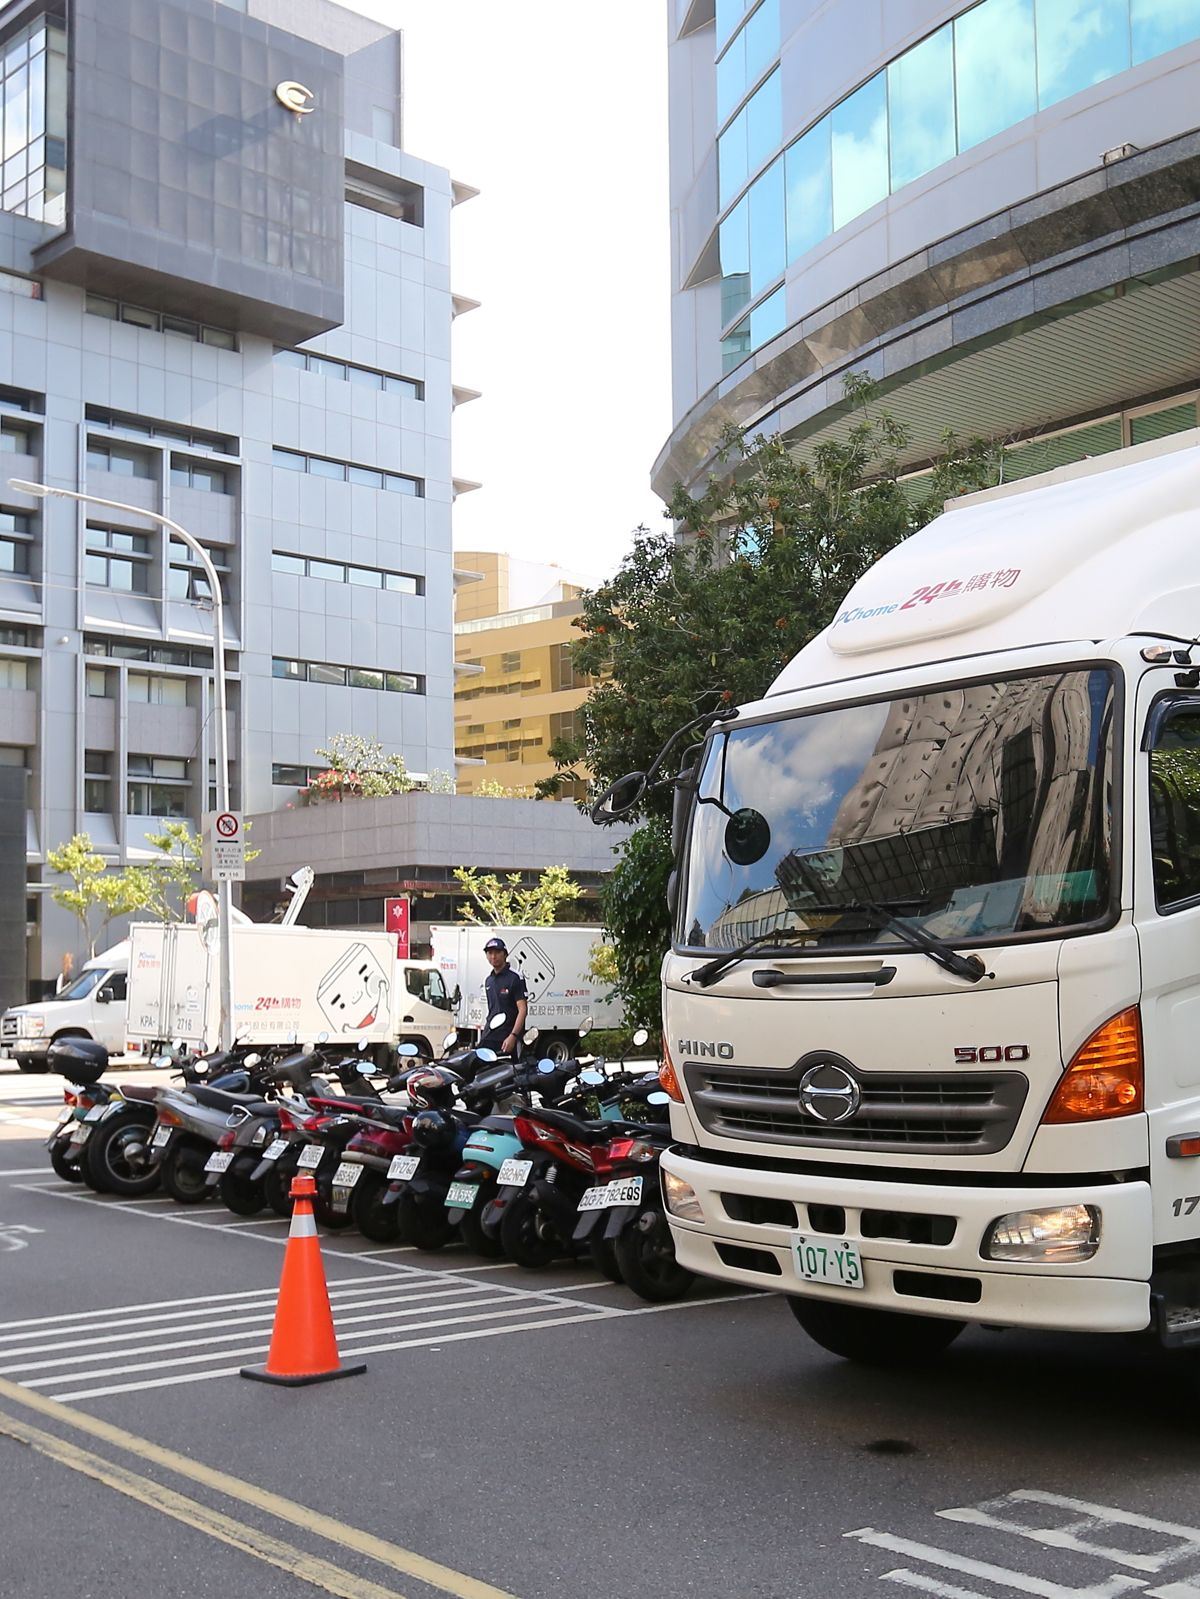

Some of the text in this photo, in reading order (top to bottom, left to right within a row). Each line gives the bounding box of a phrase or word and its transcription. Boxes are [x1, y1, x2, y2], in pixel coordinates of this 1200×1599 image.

[833, 603, 899, 628] PChome
[177, 1018, 192, 1031] 2716
[679, 1039, 1030, 1064] HINO 500
[605, 1187, 640, 1203] 782-EQS
[797, 1245, 859, 1281] 107-Y5
